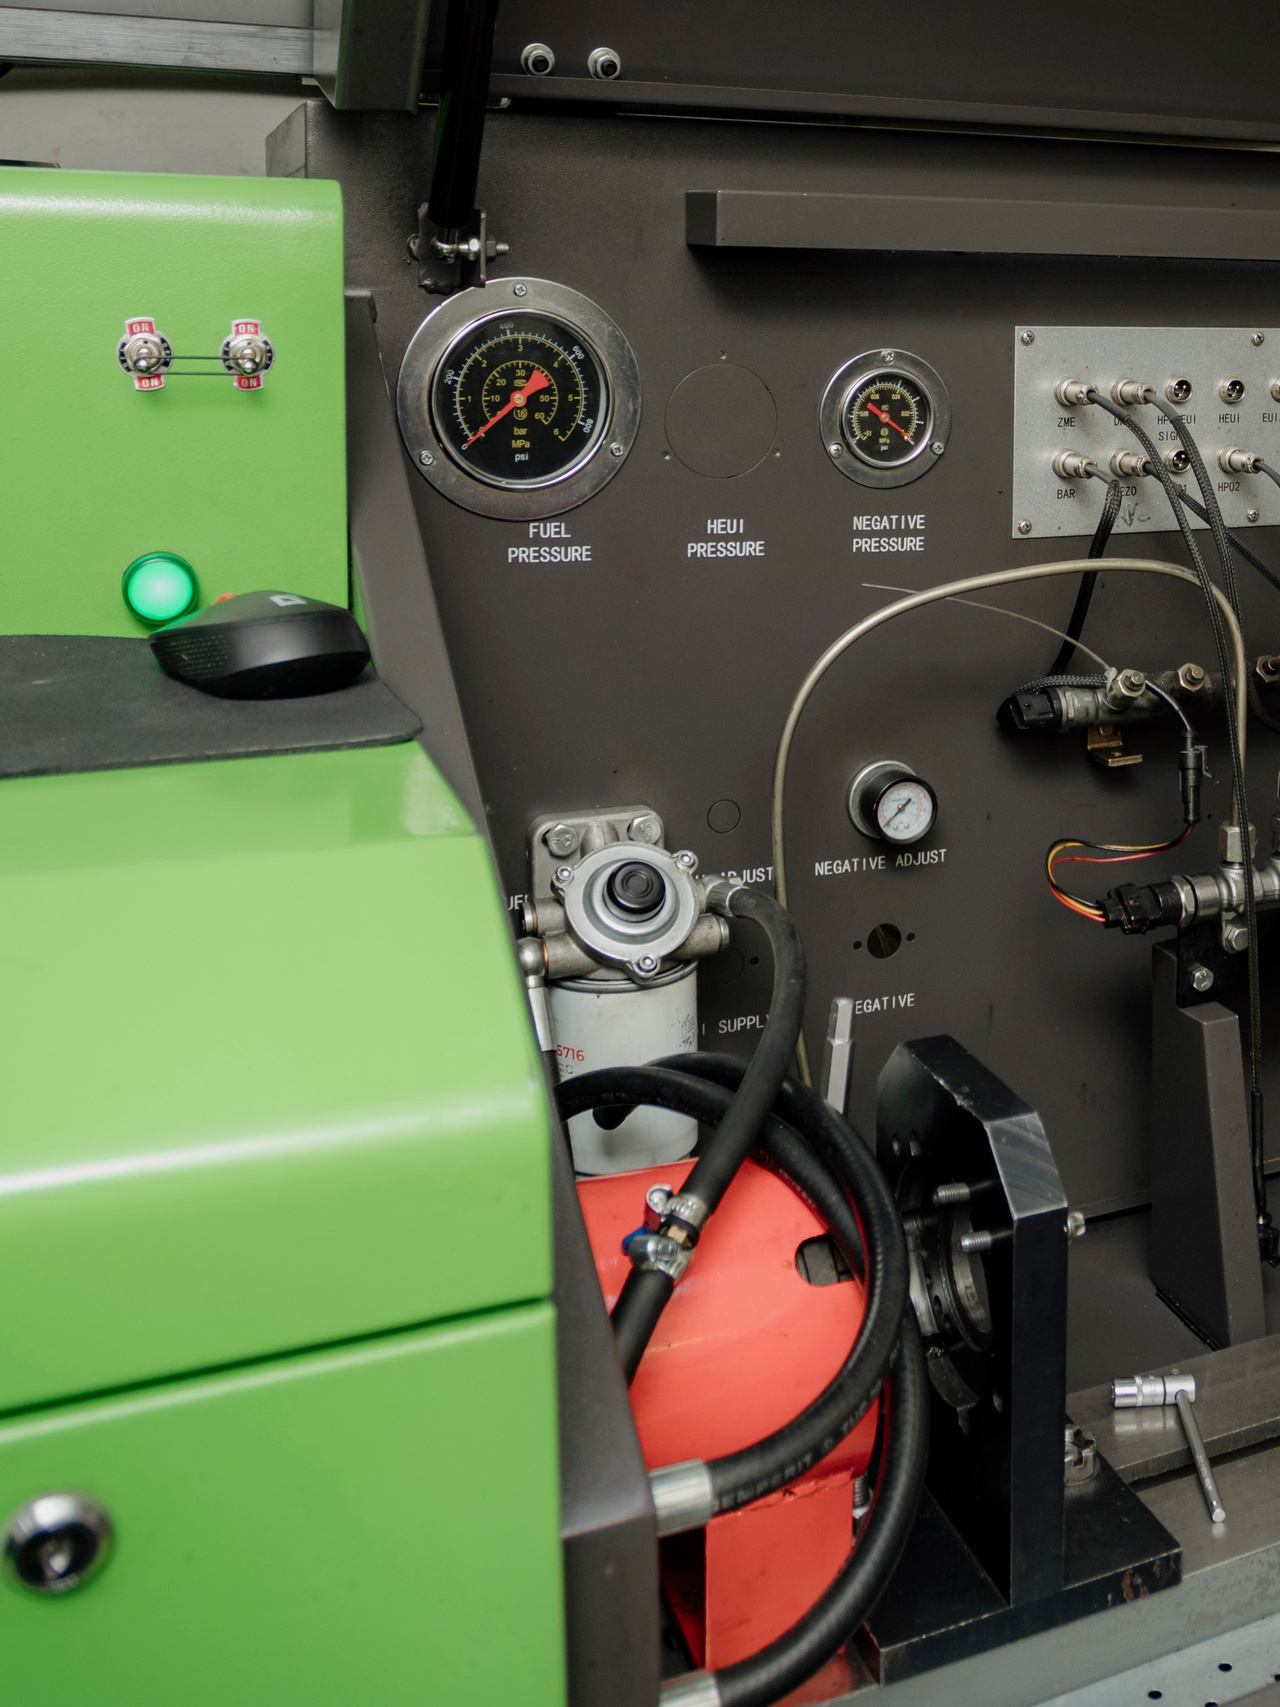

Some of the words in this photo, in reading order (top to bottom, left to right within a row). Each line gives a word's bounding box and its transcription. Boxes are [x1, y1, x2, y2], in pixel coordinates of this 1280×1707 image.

[132, 322, 150, 332] ON
[238, 324, 255, 333] ON
[499, 321, 514, 330] 400
[517, 344, 523, 352] 3
[572, 345, 585, 360] 600
[481, 360, 487, 368] 2
[444, 369, 455, 385] 200
[515, 369, 526, 377] 30
[142, 377, 159, 388] ON
[241, 377, 257, 387] ON
[496, 379, 507, 387] 20
[534, 412, 544, 420] 60
[1218, 413, 1240, 423] HEUI
[583, 418, 594, 434] 800
[1057, 417, 1076, 428] ZME
[513, 427, 528, 436] bar
[511, 440, 531, 448] MPa
[515, 452, 529, 461] psi
[1057, 489, 1076, 499] BAR
[1120, 486, 1137, 497] EZO
[707, 519, 744, 534] HEUI
[853, 514, 926, 531] NEGATIVE
[529, 522, 571, 538] FUEL
[687, 541, 765, 558] PRESSURE
[852, 536, 925, 553] PRESSURE
[508, 546, 592, 562] PRESSURE
[814, 855, 886, 876] NEGATIVE
[895, 849, 947, 868] ADJUST
[855, 993, 915, 1015] EGATIVE
[718, 1014, 770, 1034] SUPPL
